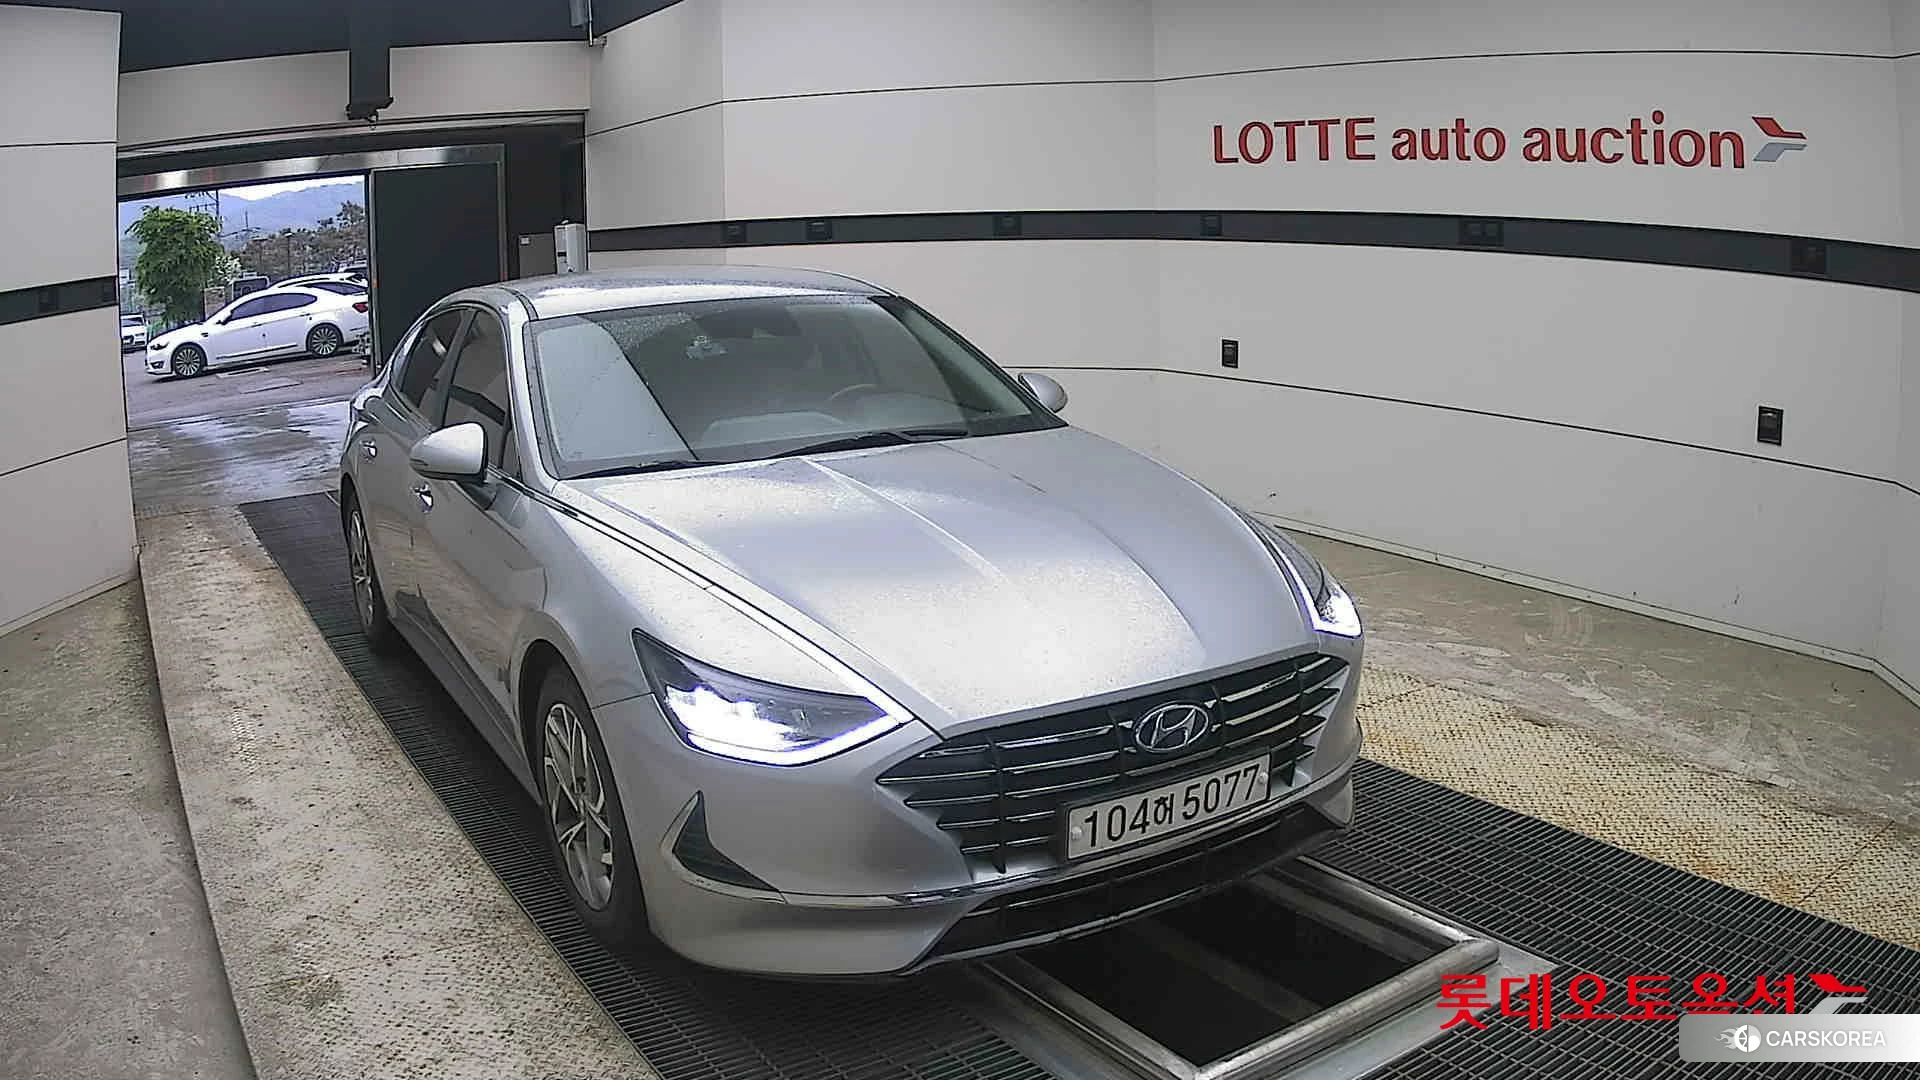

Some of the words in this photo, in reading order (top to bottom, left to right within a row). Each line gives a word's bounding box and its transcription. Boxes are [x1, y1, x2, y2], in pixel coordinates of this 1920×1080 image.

[1212, 117, 1377, 164] LOTTE
[1391, 118, 1507, 162] auto
[1521, 110, 1745, 168] auction
